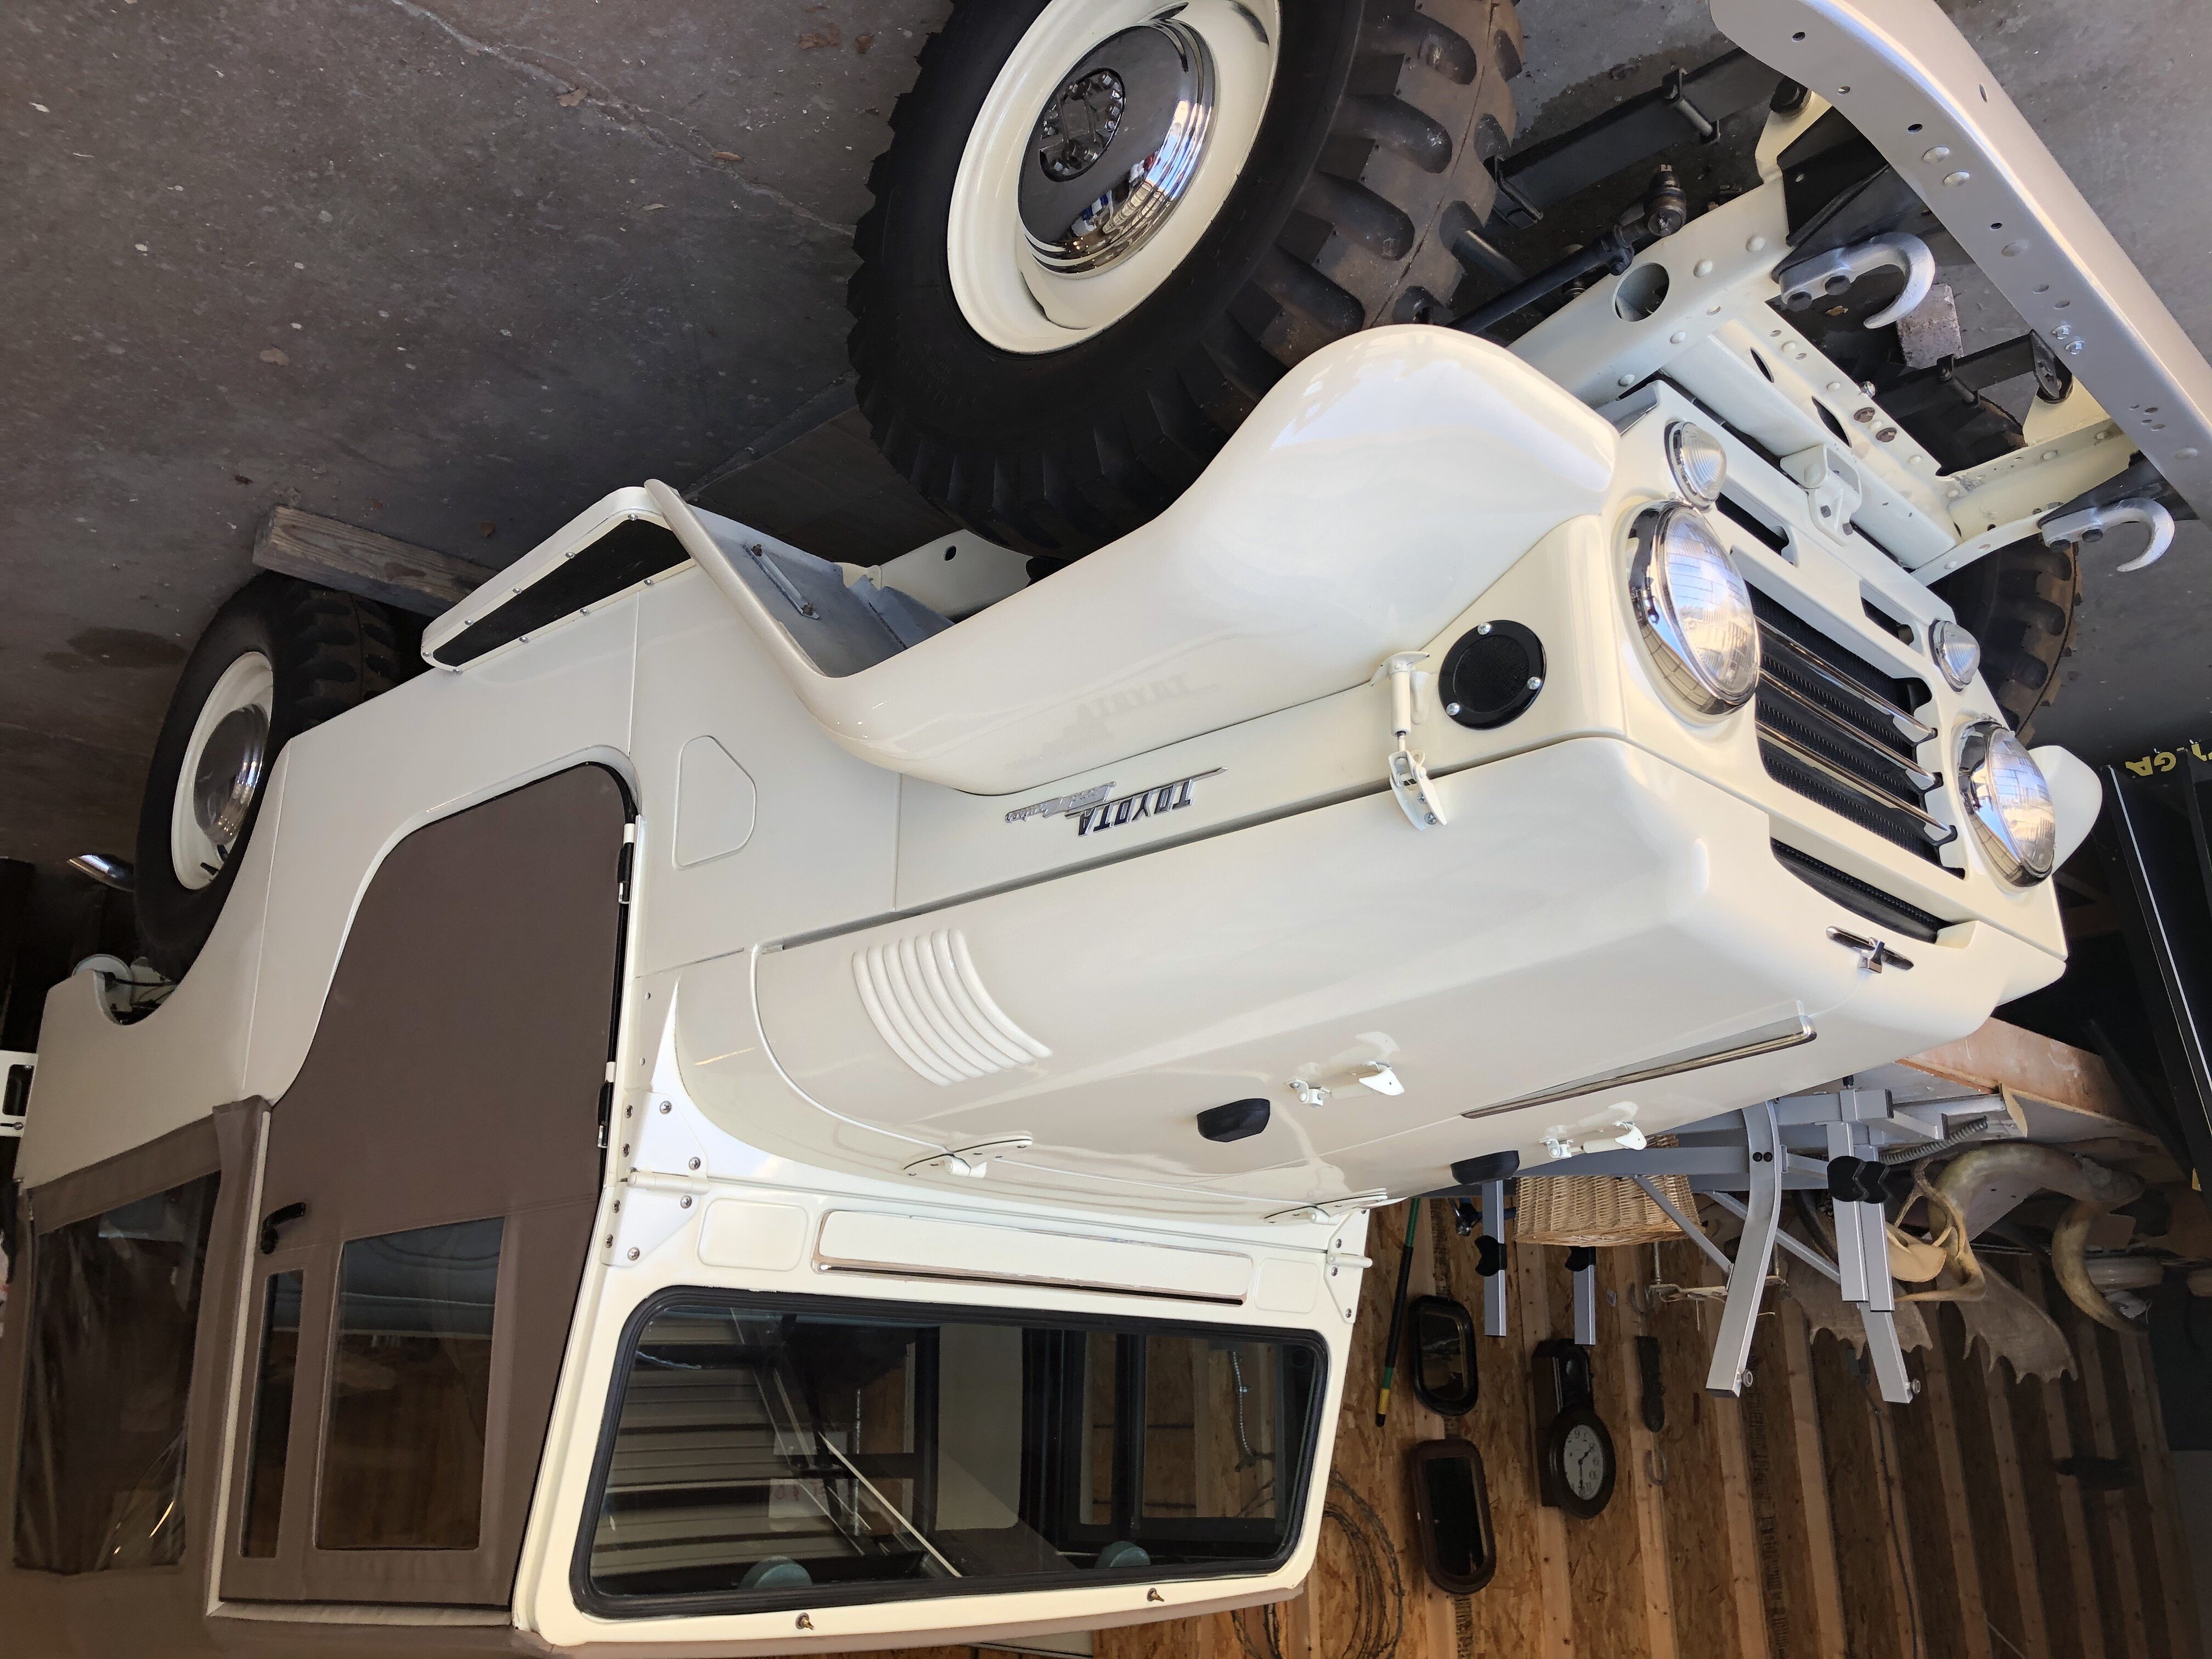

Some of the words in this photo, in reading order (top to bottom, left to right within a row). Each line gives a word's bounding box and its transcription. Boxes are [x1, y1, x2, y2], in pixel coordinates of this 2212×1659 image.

[2125, 752, 2176, 777] GA
[1068, 781, 1116, 809] Land
[1078, 778, 1193, 837] TOYOTA
[1005, 797, 1063, 824] Cruiser
